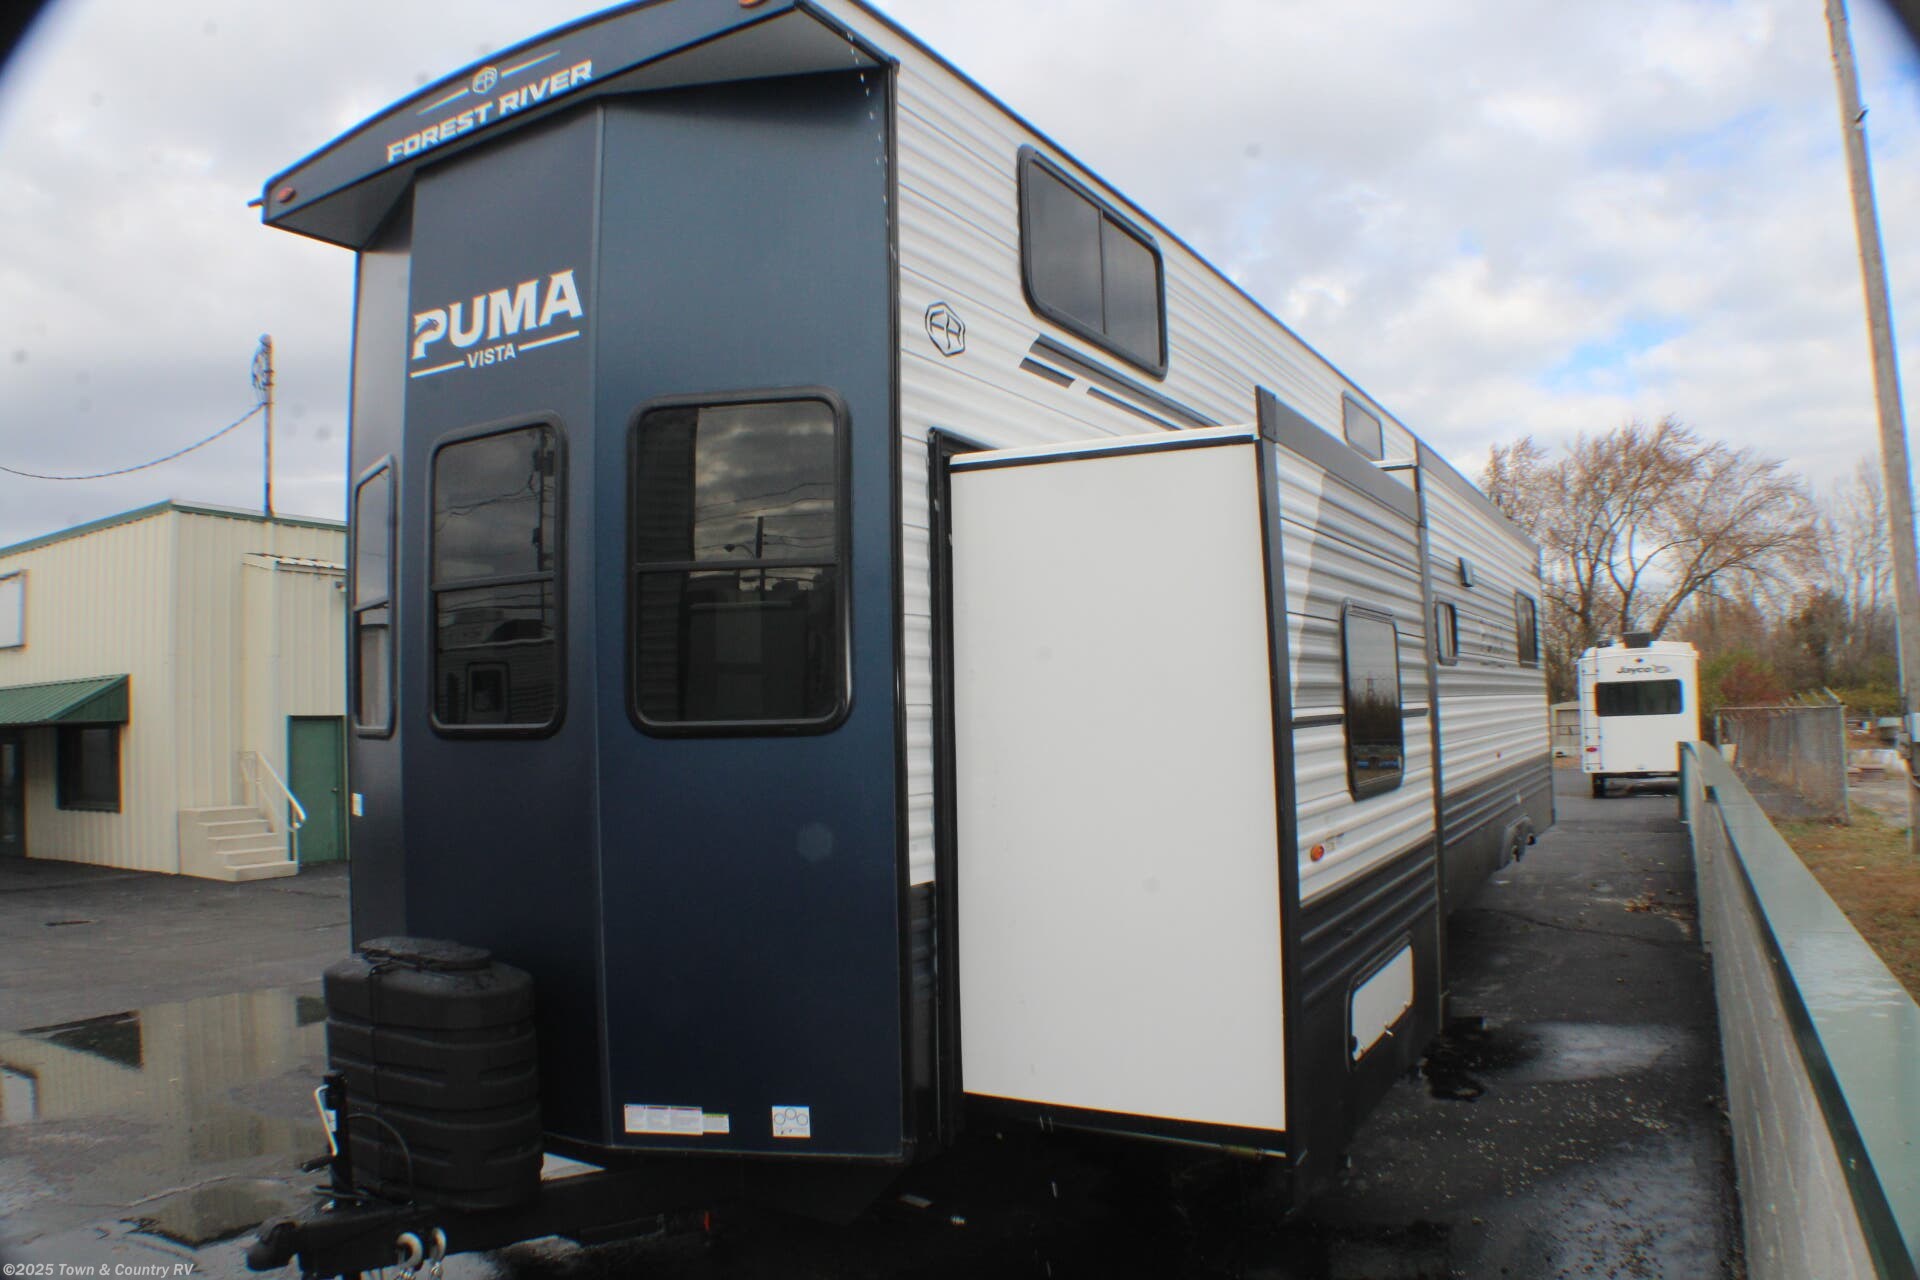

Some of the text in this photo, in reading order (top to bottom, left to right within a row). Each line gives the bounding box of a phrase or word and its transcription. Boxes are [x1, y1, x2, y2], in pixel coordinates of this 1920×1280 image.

[387, 59, 593, 163] FOREST RIVER
[412, 269, 584, 360] PUMA
[466, 343, 517, 369] VISTA
[1616, 665, 1653, 676] Jayco
